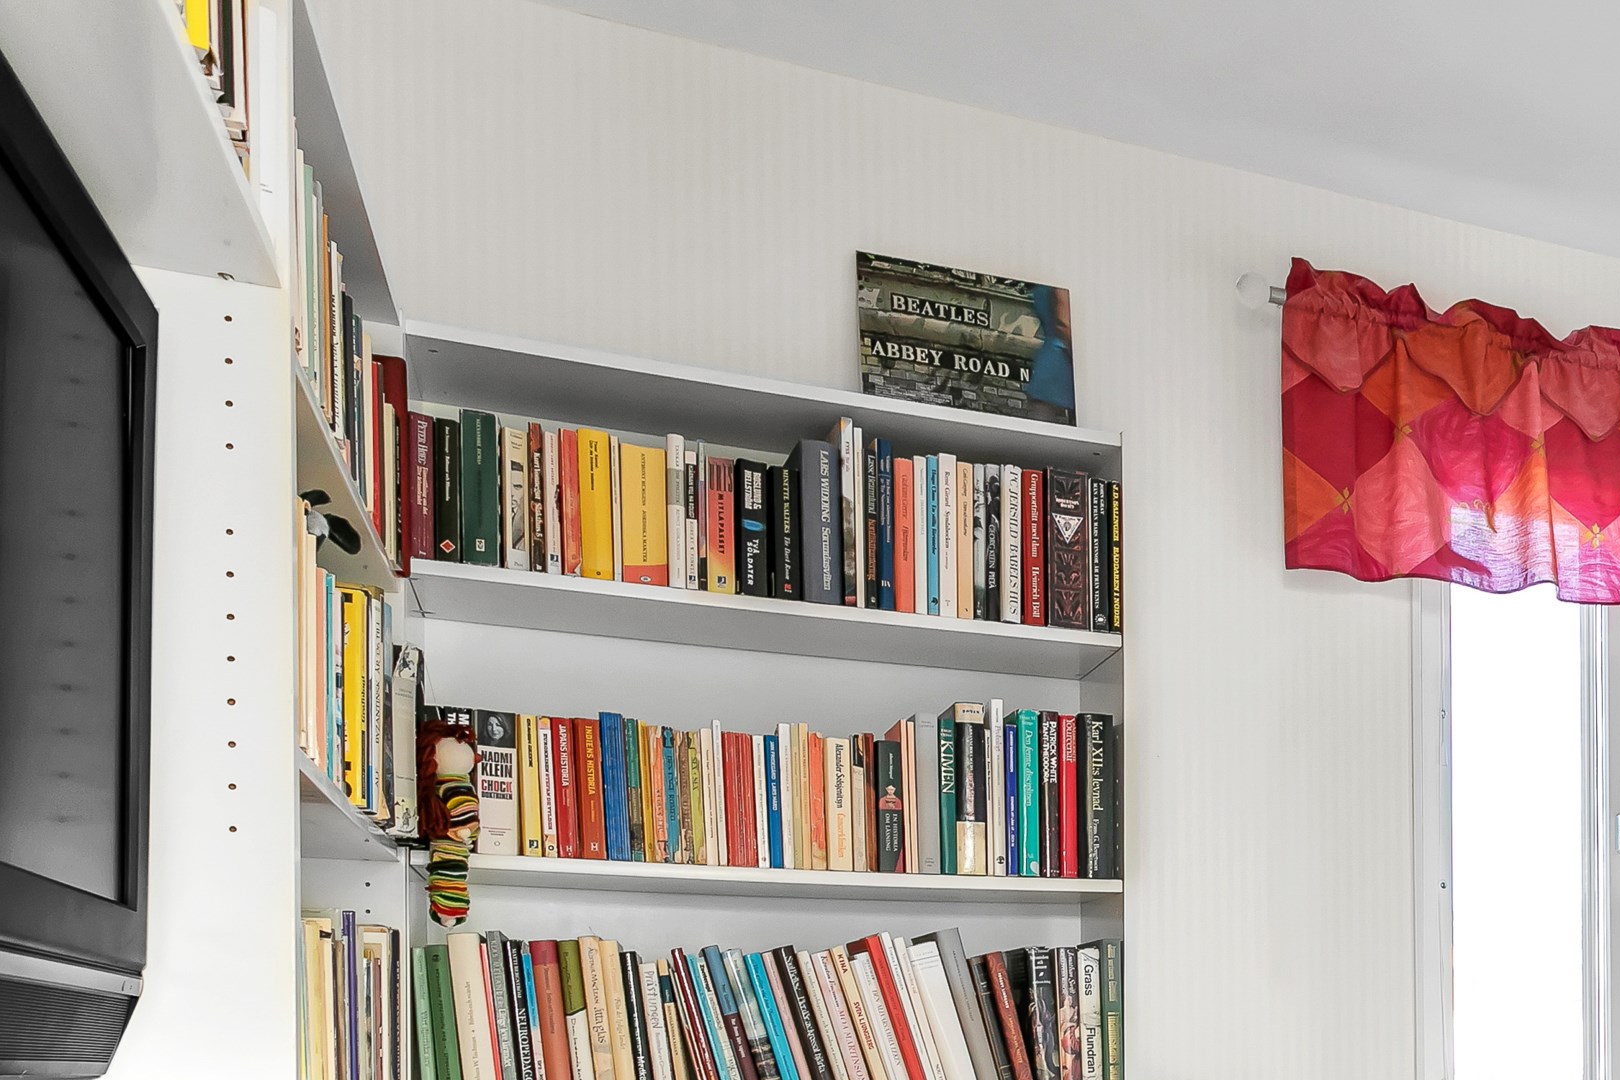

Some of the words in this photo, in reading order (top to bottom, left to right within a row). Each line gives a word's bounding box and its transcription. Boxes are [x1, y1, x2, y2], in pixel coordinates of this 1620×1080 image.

[891, 295, 989, 326] BEATLES
[871, 340, 943, 366] ABBEY
[953, 353, 1010, 378] ROAD
[820, 450, 830, 475] LARS
[744, 470, 753, 509] HELLSTRÖM
[1010, 471, 1018, 486] PC
[820, 478, 830, 522] WIDDING
[1030, 473, 1038, 521] Grupporträtt
[1009, 488, 1018, 538] JERSILD
[1009, 543, 1018, 585] BABELS
[1031, 566, 1039, 599] Heinrich
[1010, 590, 1018, 615] HUS
[1032, 601, 1040, 617] Böll
[558, 724, 567, 751] JAPANS
[585, 725, 594, 758] INDIENS
[1066, 718, 1075, 764] Yourcenar
[1092, 721, 1103, 743] Karl
[480, 750, 513, 765] NAOMI
[481, 763, 513, 778] KLEIN
[560, 752, 569, 787] HISTORIA
[940, 740, 955, 794] KIMEN
[1092, 748, 1103, 775] XII:s
[481, 780, 513, 792] CHOCK
[586, 759, 595, 795] HISTORIA
[1092, 778, 1104, 811] levnad
[885, 813, 891, 823] OM
[892, 813, 898, 822] EN
[837, 953, 848, 974] KINA
[1066, 949, 1076, 977] Jonathan
[1067, 978, 1077, 996] Swift
[1083, 963, 1094, 996] Grass
[643, 970, 663, 1029] Prästungen
[853, 1001, 863, 1017] SVEN
[836, 1009, 850, 1030] MOA
[856, 1018, 874, 1050] LJUNGBERG
[1085, 1027, 1096, 1073] Flundran
